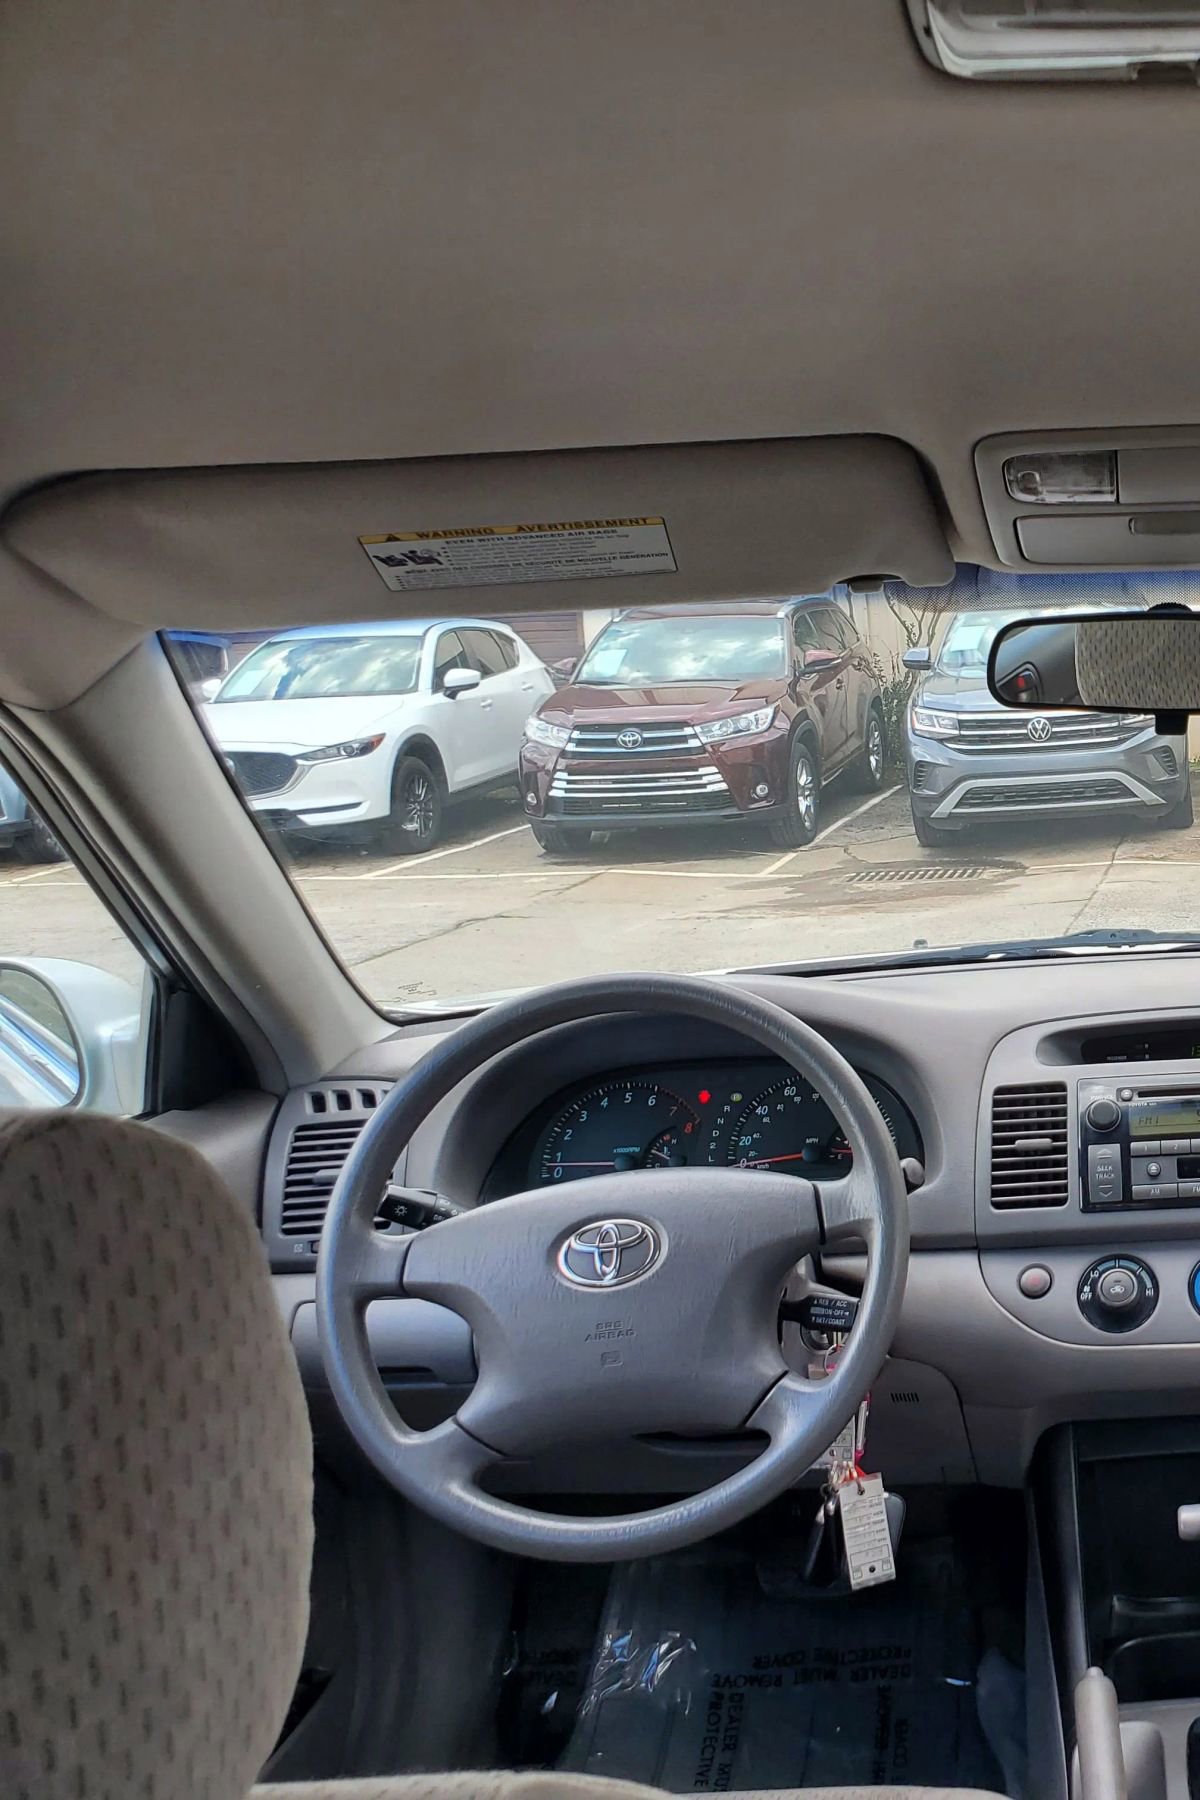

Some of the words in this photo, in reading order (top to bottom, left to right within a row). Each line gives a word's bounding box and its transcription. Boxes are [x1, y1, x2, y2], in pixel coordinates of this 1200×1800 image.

[416, 526, 497, 539] WARNING
[517, 517, 648, 532] AVERTISSEMENT
[784, 1086, 796, 1096] 60
[600, 1097, 608, 1108] 4
[624, 1092, 632, 1103] 5
[647, 1095, 656, 1106] 6
[669, 1106, 678, 1117] 7
[755, 1105, 768, 1115] 40
[579, 1110, 588, 1122] 3
[717, 1117, 724, 1125] N
[684, 1122, 693, 1133] 8
[712, 1129, 720, 1137] D
[564, 1129, 573, 1140] 2
[709, 1141, 717, 1149] 2
[739, 1135, 752, 1146] 20
[555, 1151, 562, 1163] 1
[554, 1167, 563, 1178] 0
[1095, 1172, 1115, 1180] TRACK
[1090, 1270, 1099, 1278] LO
[1080, 1291, 1092, 1301] OFF
[1145, 1287, 1154, 1297] HI
[712, 1672, 782, 1689] REMOVE
[721, 1692, 745, 1753] DEALER
[694, 1691, 725, 1788] PROTECTIVE
